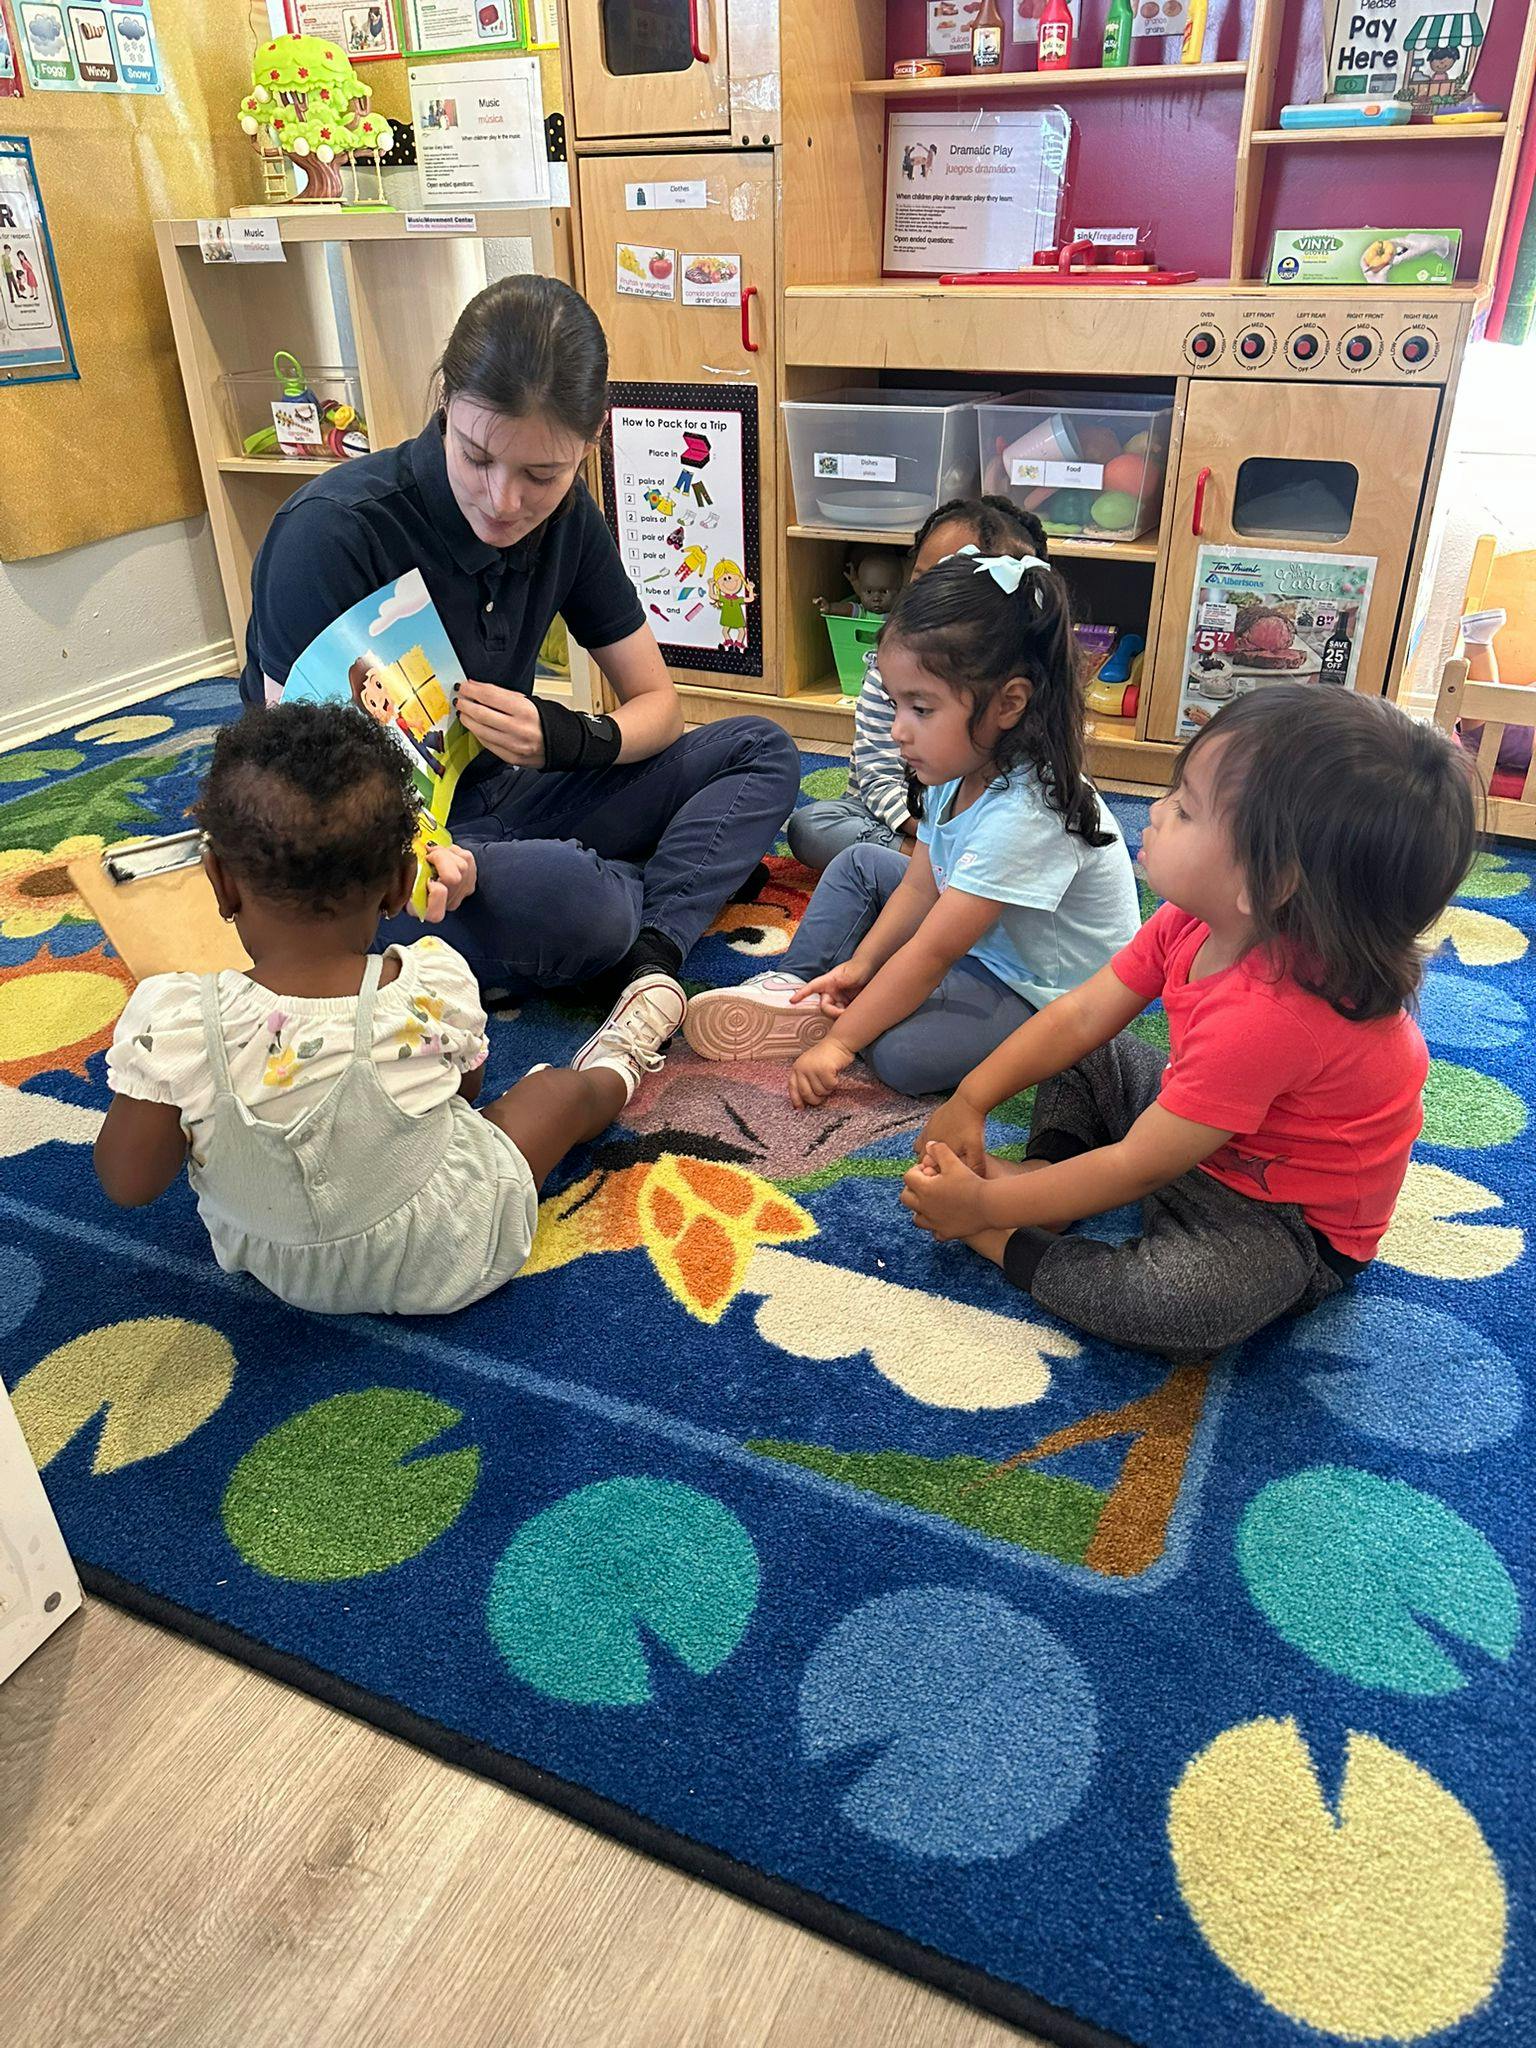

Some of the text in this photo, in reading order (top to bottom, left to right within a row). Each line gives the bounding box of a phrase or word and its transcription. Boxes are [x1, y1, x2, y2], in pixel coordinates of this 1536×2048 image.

[1349, 15, 1397, 43] Pay
[1338, 46, 1398, 70] Here
[40, 63, 67, 78] Foggy
[85, 64, 111, 79] Windy
[127, 69, 150, 81] Snowy
[478, 98, 500, 108] Music
[949, 145, 1014, 158] Dramatic Play
[945, 164, 973, 176] juegos
[670, 185, 689, 193] Clothes
[932, 193, 944, 202] play
[974, 195, 986, 203] play
[986, 195, 998, 203] they
[244, 228, 265, 238] Music
[1077, 231, 1134, 242] sink/fregadero
[893, 235, 909, 244] Open
[910, 235, 926, 243] ended
[1298, 238, 1338, 251] VINYL
[622, 417, 643, 428] How
[645, 419, 655, 428] to
[657, 419, 683, 429] Pack
[684, 420, 698, 429] for
[709, 421, 727, 432] Trip
[648, 449, 678, 458] Place in
[638, 478, 655, 487] pairs
[656, 477, 665, 486] of
[627, 495, 632, 503] 2
[640, 515, 658, 524] pairs
[658, 516, 667, 524] of
[642, 533, 658, 542] pair
[659, 534, 665, 542] of
[643, 551, 658, 561] pair
[658, 552, 666, 560] of
[1212, 561, 1261, 573] Tom Thumb
[1222, 576, 1265, 588] Albertsons
[1275, 569, 1335, 593] Easter
[645, 587, 670, 596] tube of
[666, 606, 681, 615] and
[1329, 640, 1349, 648] SAVE
[1324, 648, 1344, 663] 25
